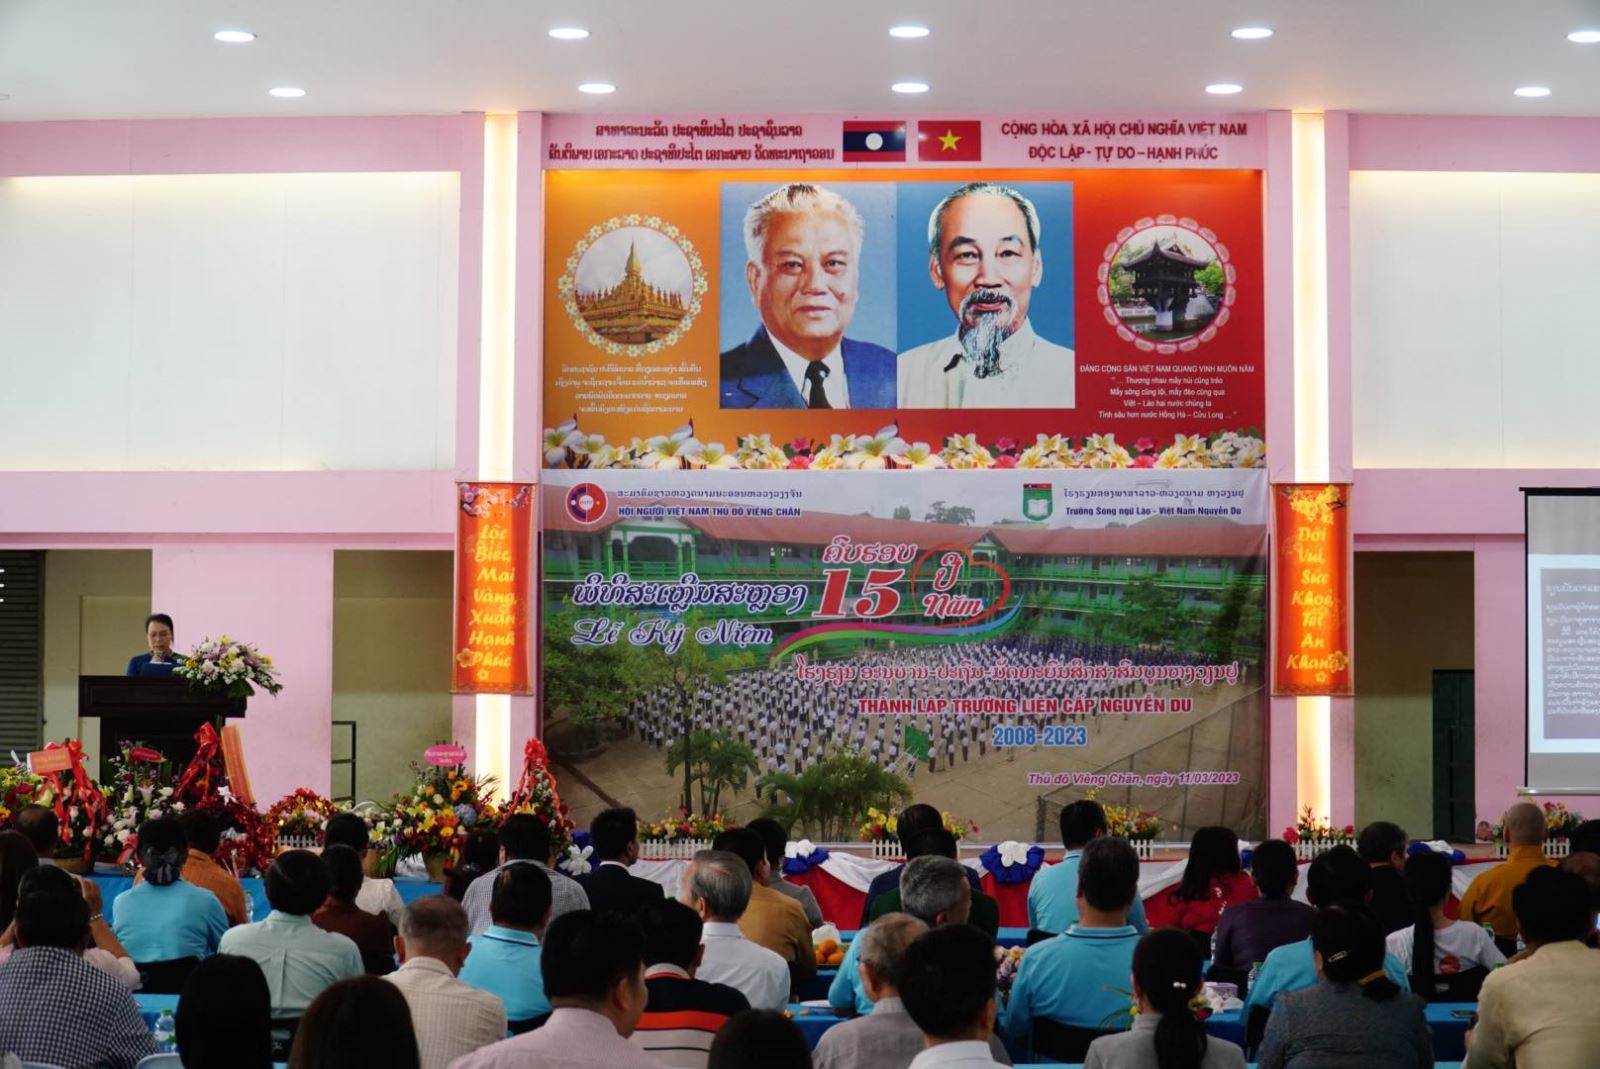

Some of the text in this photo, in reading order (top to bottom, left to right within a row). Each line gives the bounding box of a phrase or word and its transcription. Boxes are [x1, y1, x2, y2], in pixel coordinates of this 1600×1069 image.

[1001, 120, 1038, 139] CỘNG
[1042, 120, 1068, 135] HÒA
[1073, 119, 1090, 135] XÃ
[1094, 120, 1115, 139] HỘI
[1119, 120, 1144, 135] CHỦ
[1148, 120, 1185, 135] NGHĨA
[1220, 123, 1247, 135] NAM
[1028, 144, 1056, 162] ĐỘC
[1094, 146, 1113, 162] TỰ
[1185, 144, 1218, 159] PHÚC
[1156, 365, 1171, 373] NAM
[1172, 365, 1197, 373] QUANG
[1199, 365, 1216, 373] VINH
[618, 506, 634, 516] HỘI
[636, 506, 664, 515] NGƯỜI
[688, 507, 709, 515] NAM
[732, 505, 744, 515] ĐÔ
[746, 505, 773, 515] VIÊNG
[1096, 507, 1117, 516] Song
[1177, 507, 1195, 515] Nam
[1230, 507, 1242, 515] Du
[823, 535, 918, 563] ຄົບຮອບ
[477, 567, 516, 582] Mai
[933, 552, 963, 591] ປີ
[1301, 568, 1329, 584] Sức
[812, 568, 905, 618] 15
[922, 593, 984, 619] Năm
[571, 617, 624, 645] Lễ
[695, 618, 773, 648] Niệm
[1300, 633, 1324, 648] An
[474, 649, 512, 667] Phúc
[859, 695, 912, 713] THÀNH
[952, 695, 1017, 713] TRƯỜNG
[1022, 696, 1058, 713] LIÊN
[1062, 694, 1095, 713] CẤP
[1100, 693, 1165, 713] NGUYỄN
[1170, 698, 1192, 713] DU
[992, 726, 1087, 747] 2008-2023
[1028, 774, 1050, 785] Thủ
[1054, 773, 1068, 785] đô
[1073, 773, 1106, 787] Viêng
[1146, 774, 1175, 787] ngày
[1178, 772, 1240, 785] 11/03/2023
